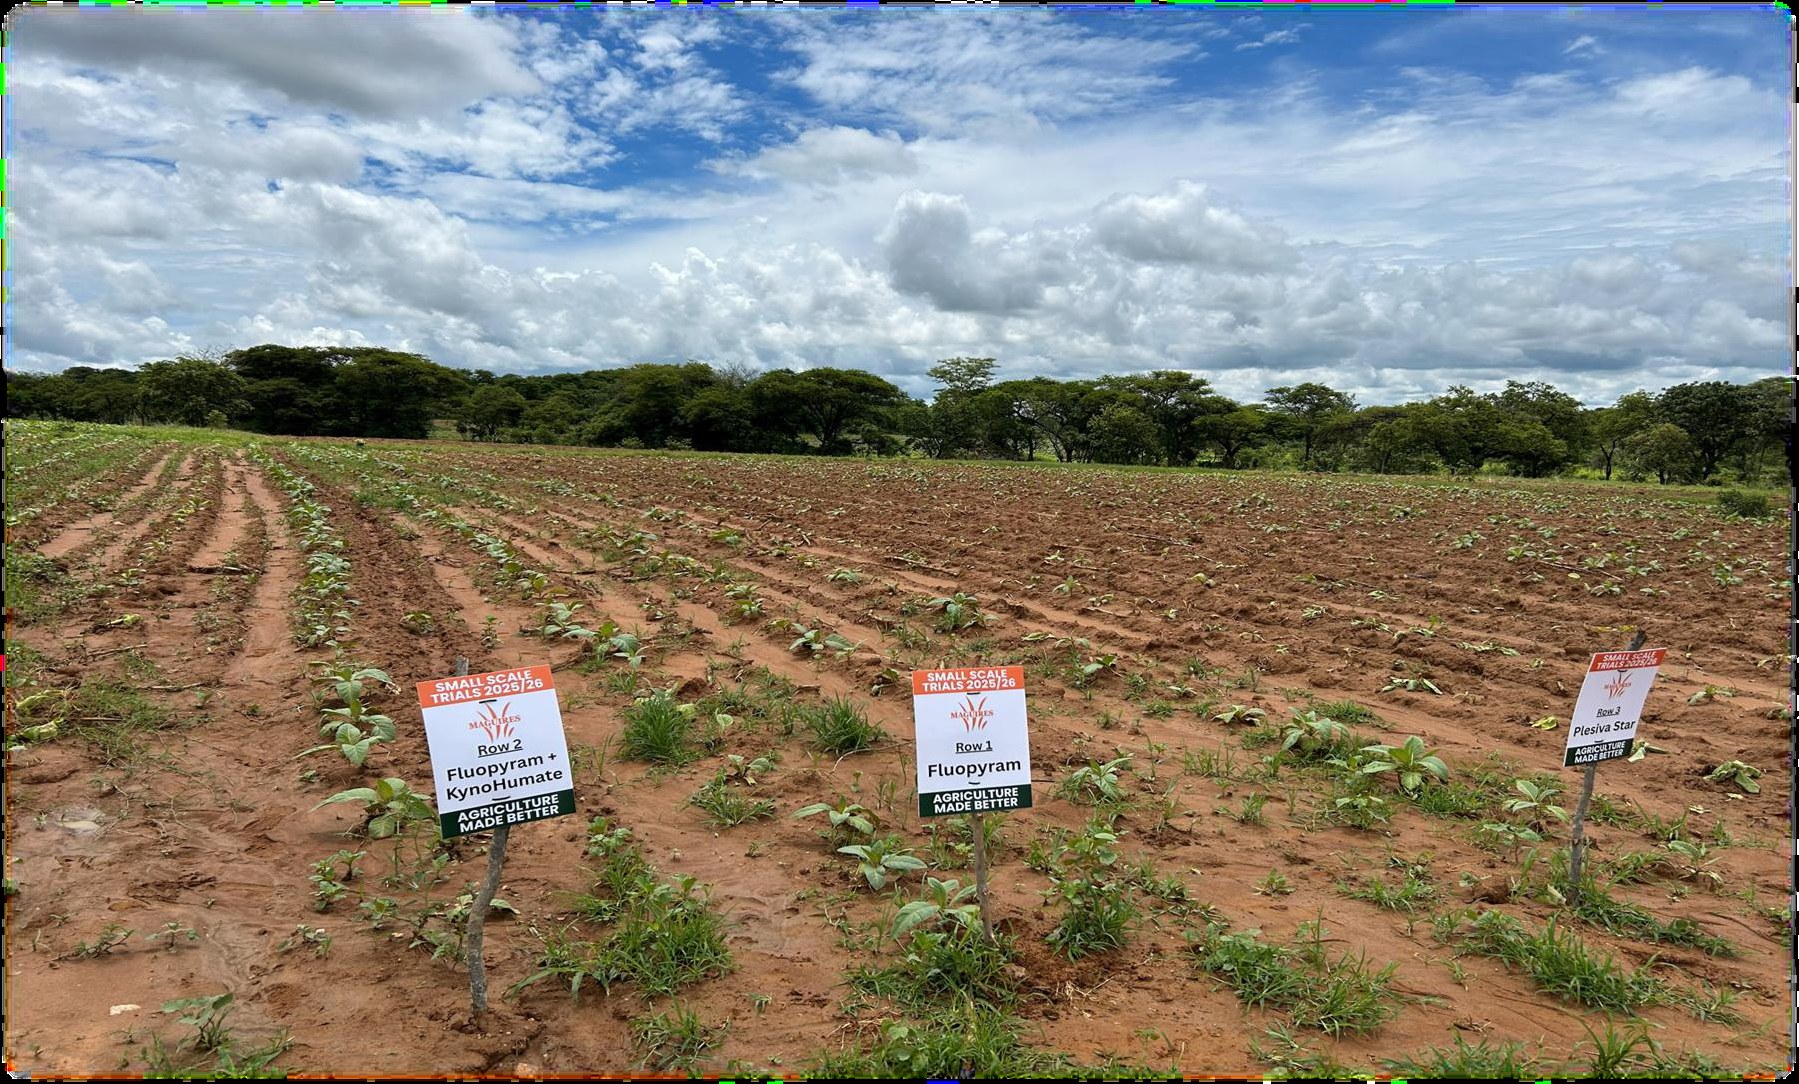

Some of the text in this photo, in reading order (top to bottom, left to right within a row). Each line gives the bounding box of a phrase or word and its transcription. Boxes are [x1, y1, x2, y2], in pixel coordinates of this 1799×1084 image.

[1596, 657, 1657, 670] TRIALS 2025/26
[1603, 651, 1656, 662] SMALL SCALE
[435, 669, 532, 693] SMALL SCALE
[922, 676, 1016, 692] TRIALS 2025/26
[927, 669, 1008, 682] SMALL SCALE
[430, 678, 544, 704] TRIALS 2025/26
[950, 709, 994, 719] MAGUIRES
[1596, 706, 1621, 717] Row 3
[468, 714, 521, 729] MAGUIRES
[1573, 720, 1636, 737] Plesiva Star
[477, 738, 522, 757] Row 2
[956, 740, 993, 753] Row 1
[1575, 741, 1625, 756] AGRICULTURE
[1574, 748, 1624, 764] MADE BETTER
[446, 752, 557, 781] Fluopyram +
[928, 760, 1021, 778] Fluopyram
[446, 770, 563, 801] KynoHumate
[932, 787, 1019, 804] AGRICULTURE
[457, 793, 559, 822] AGRICULTURE
[934, 797, 1018, 814] MADE BETTER
[459, 804, 559, 833] MADE BETTER
